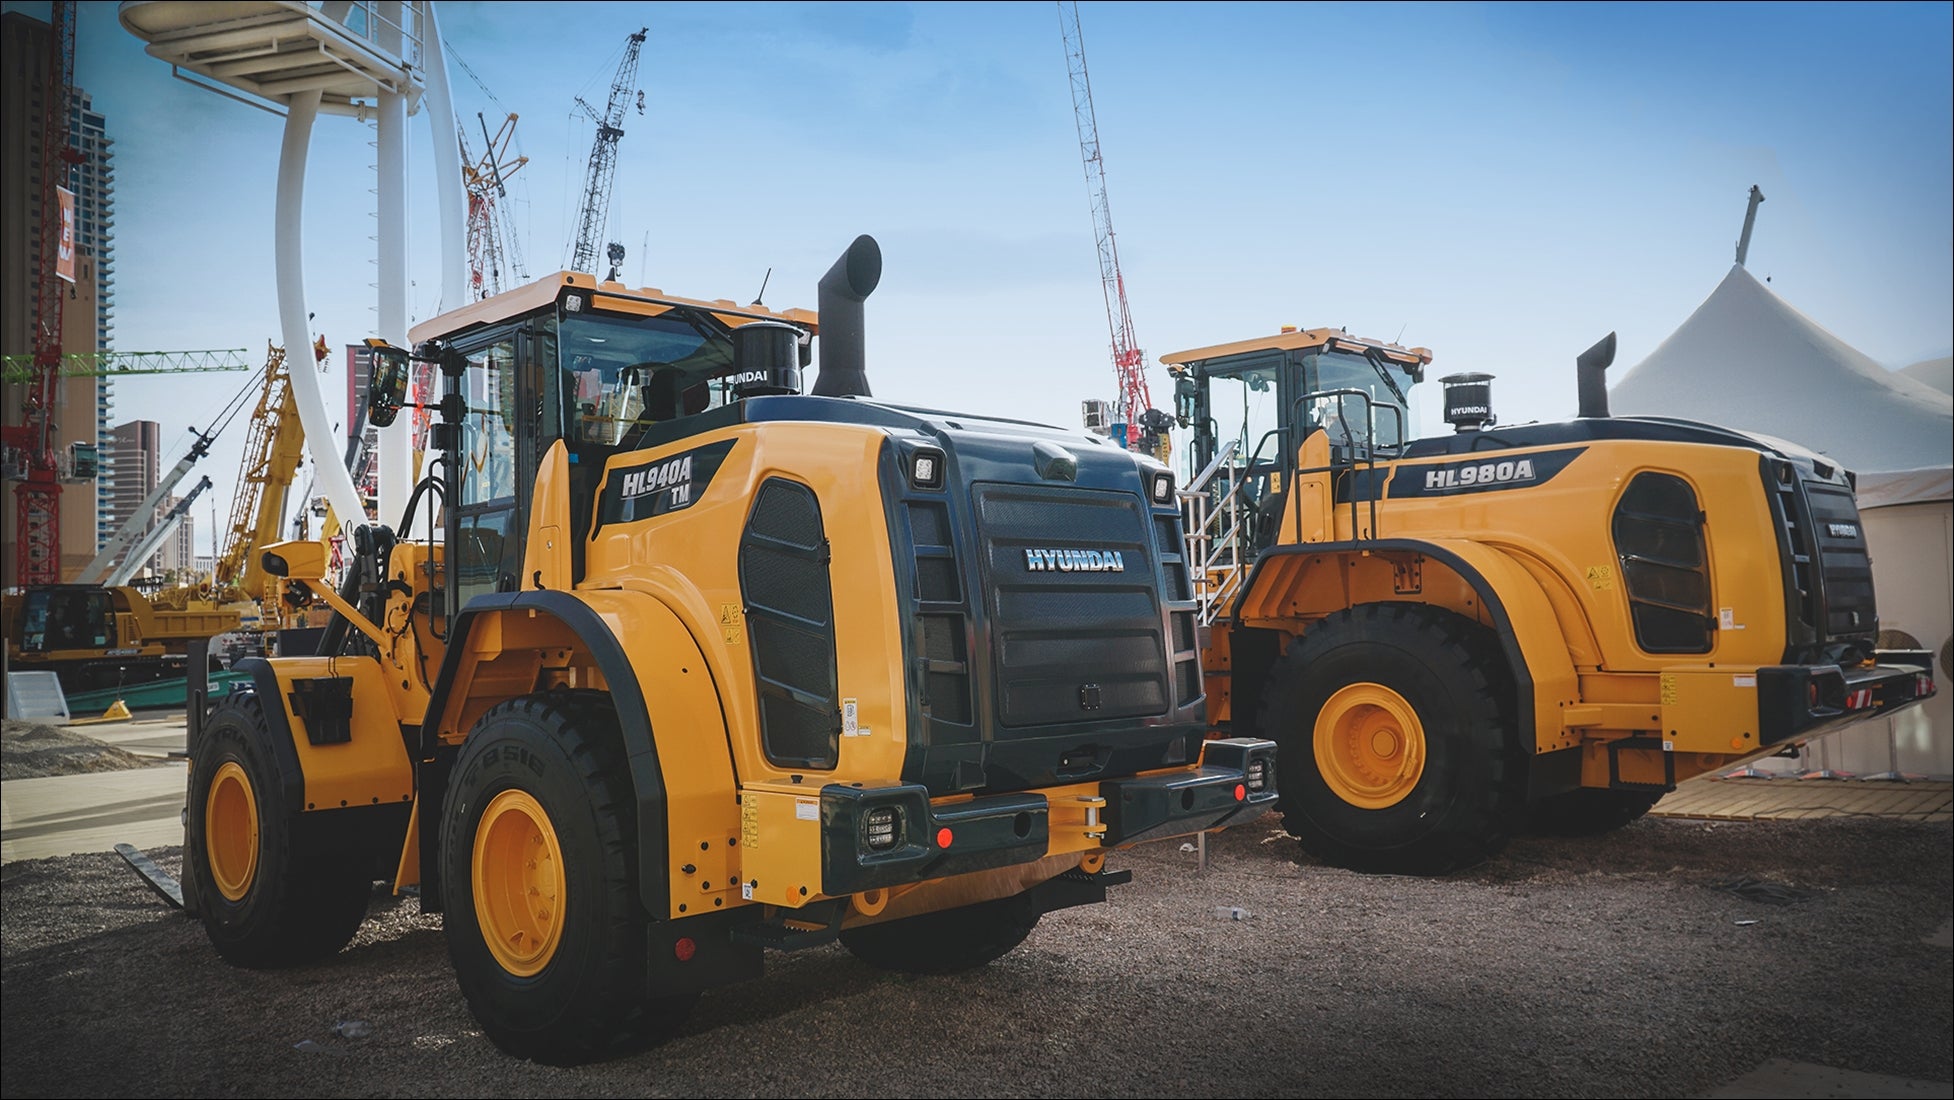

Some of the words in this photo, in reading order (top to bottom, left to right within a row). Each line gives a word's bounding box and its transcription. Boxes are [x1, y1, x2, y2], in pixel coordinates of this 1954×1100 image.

[58, 207, 72, 262] NEW
[733, 370, 768, 384] UNDAI
[1450, 405, 1488, 416] HYUNDAI
[622, 455, 692, 497] HL940A
[1425, 459, 1533, 488] HL980A
[671, 483, 690, 505] TM
[1025, 548, 1125, 572] HYUNDAI
